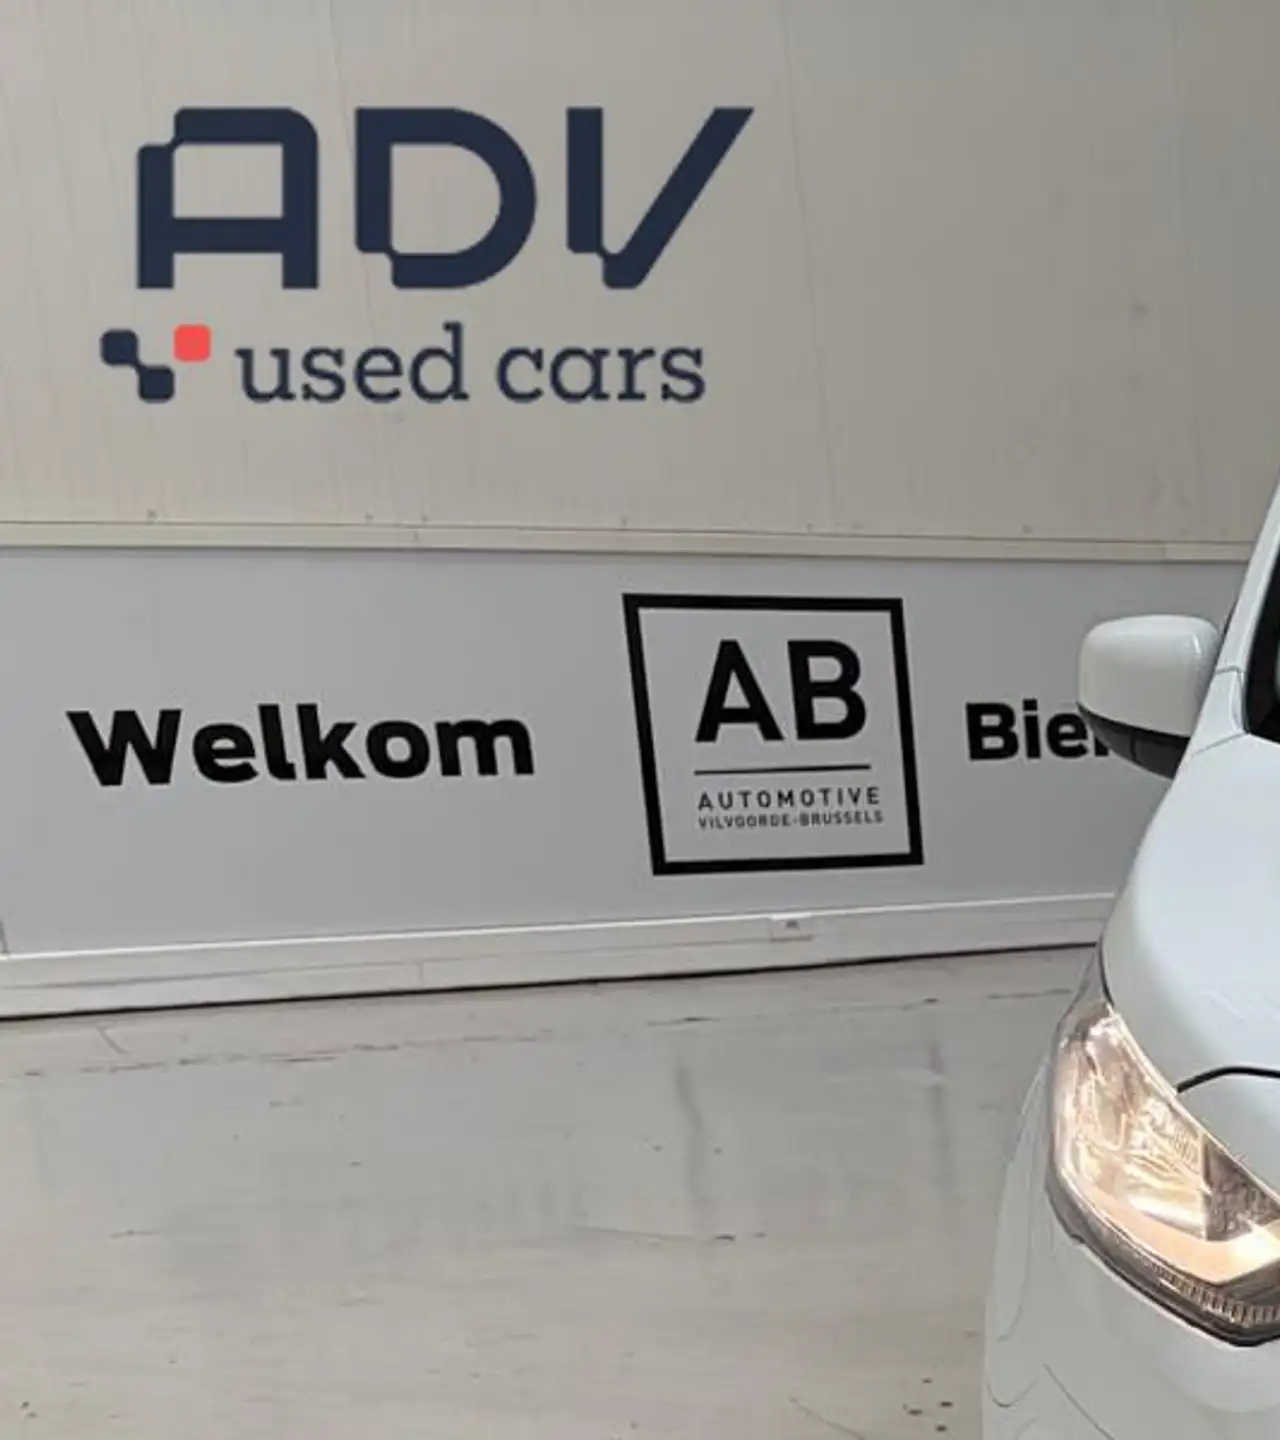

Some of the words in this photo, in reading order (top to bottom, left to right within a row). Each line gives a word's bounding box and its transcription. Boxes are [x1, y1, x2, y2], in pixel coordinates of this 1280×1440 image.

[137, 107, 754, 289] ADV
[236, 322, 469, 403] used
[497, 348, 705, 403] cars
[696, 640, 866, 742] AB
[67, 704, 533, 785] Welkom
[699, 787, 878, 810] AUTOMOTIVE
